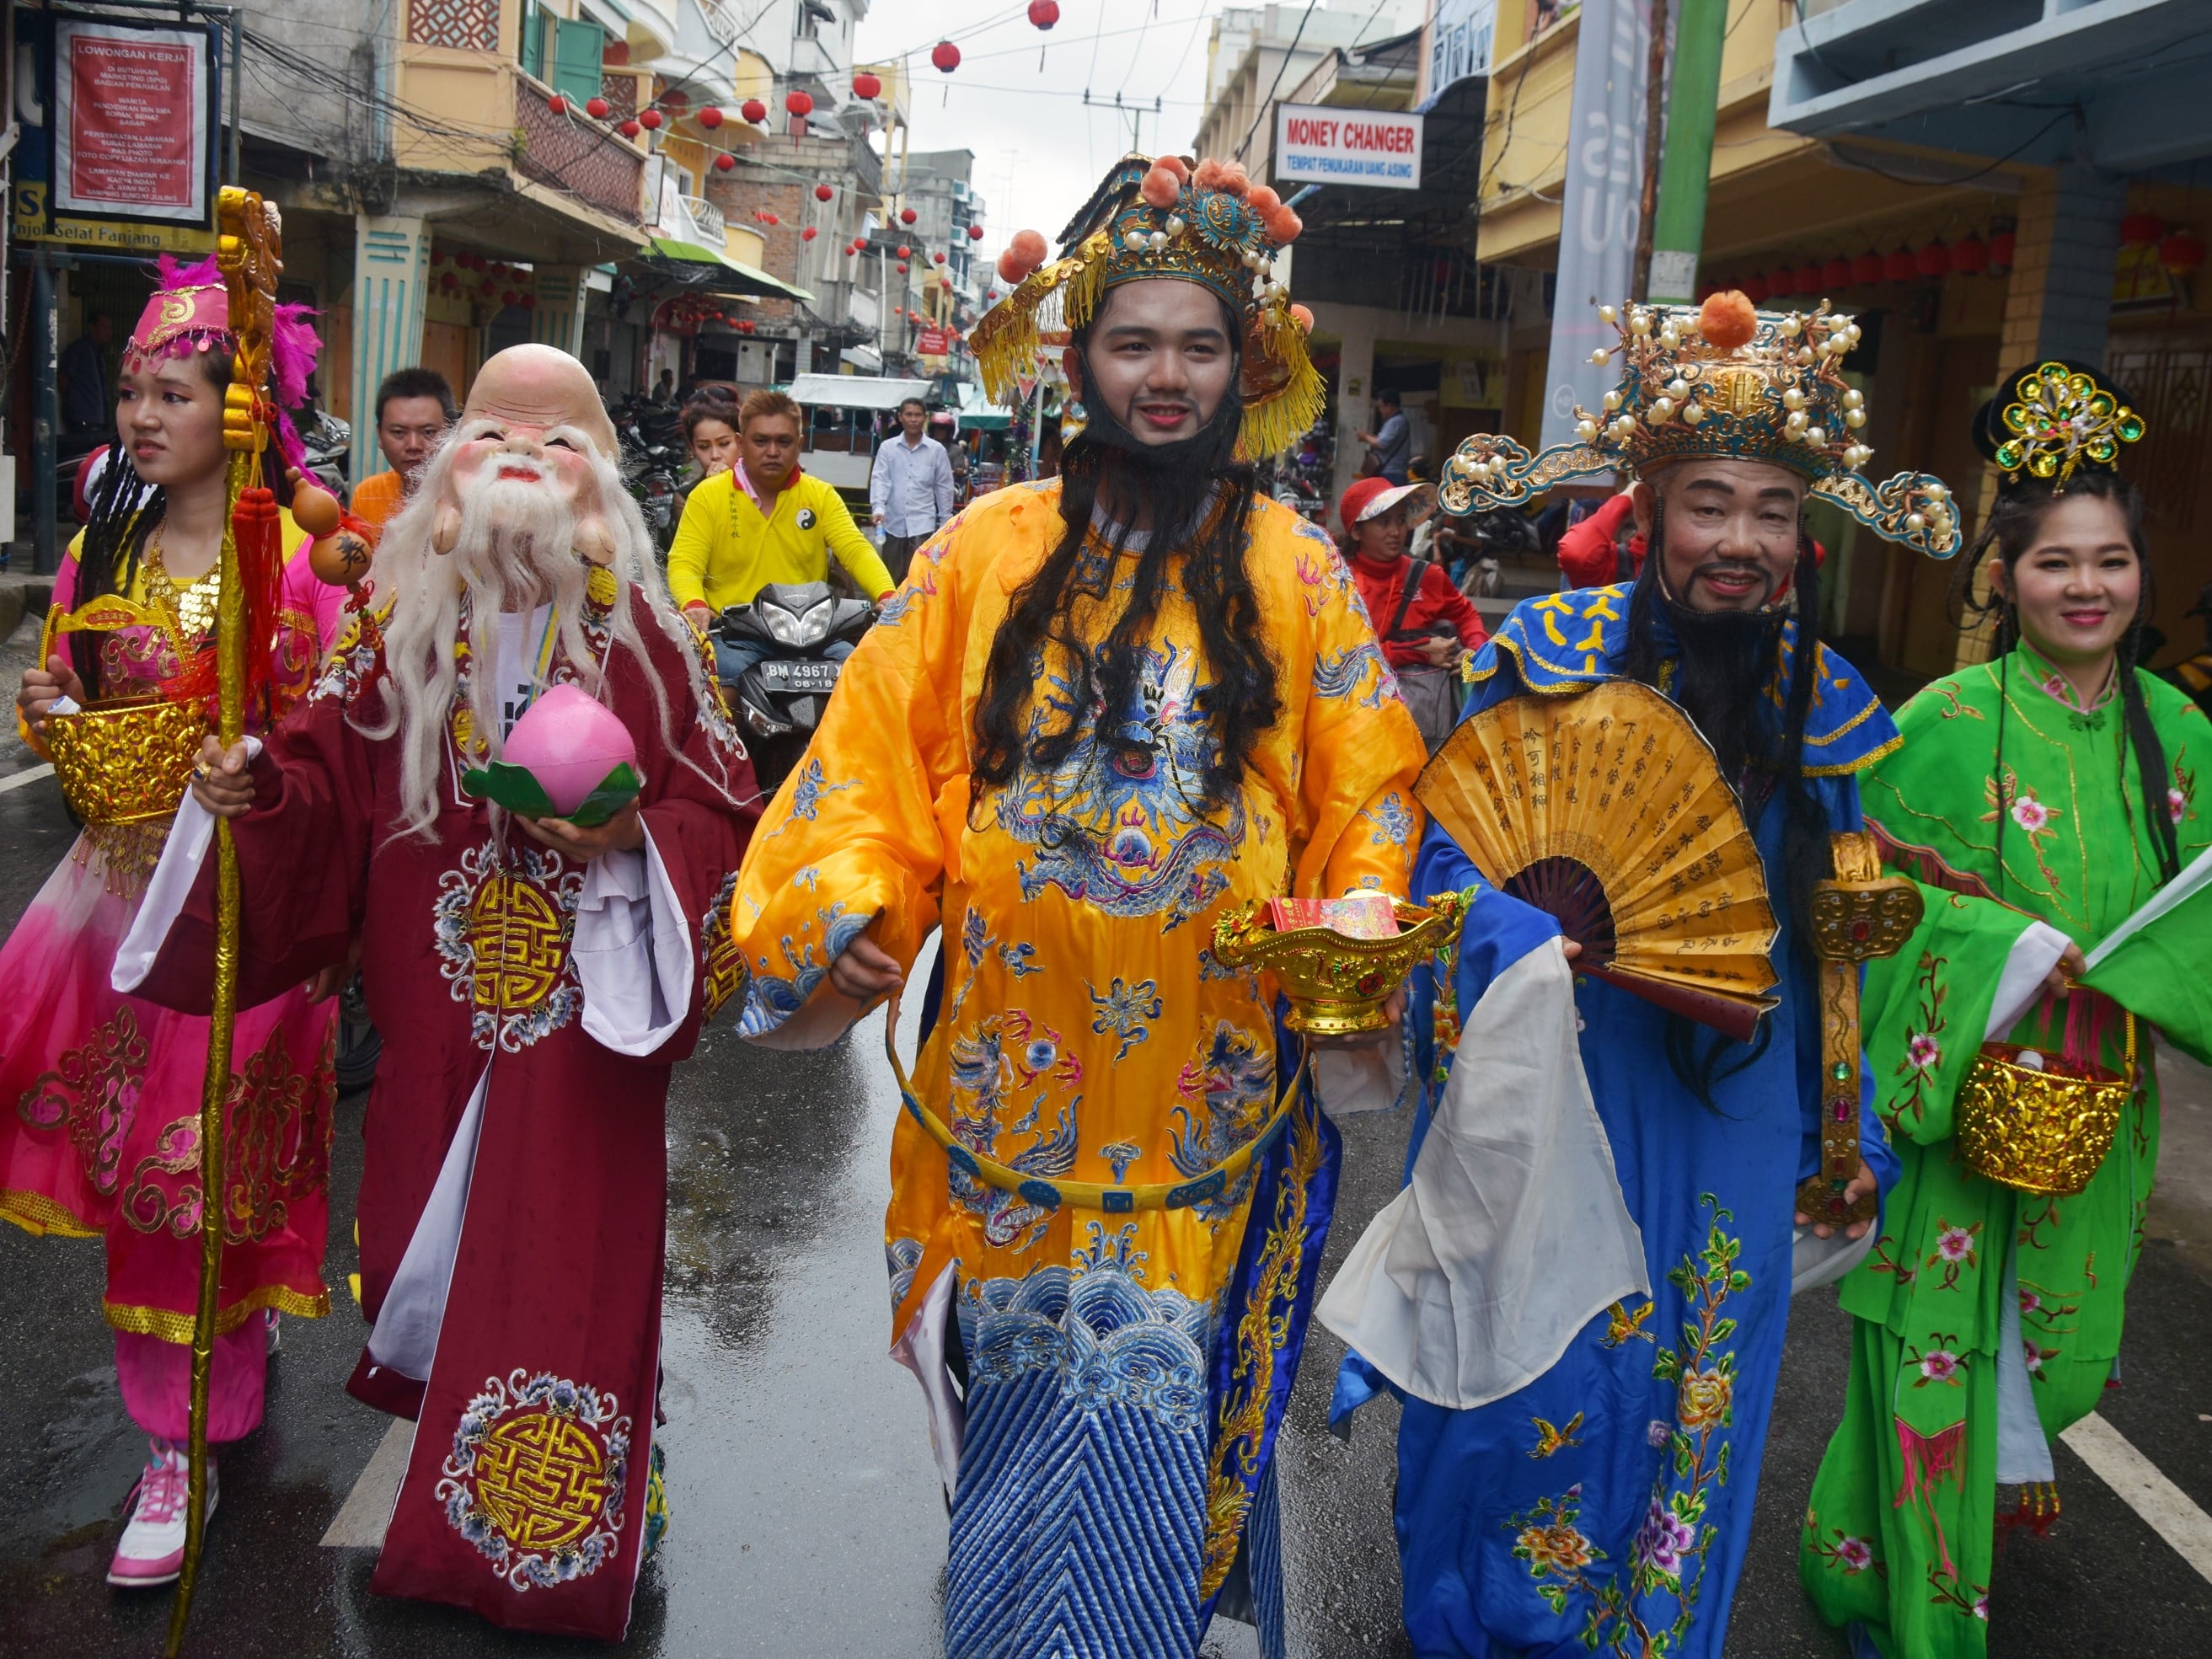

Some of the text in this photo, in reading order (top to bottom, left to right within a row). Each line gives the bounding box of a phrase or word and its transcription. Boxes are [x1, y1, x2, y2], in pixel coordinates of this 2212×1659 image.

[78, 45, 185, 62] LOWONGAN KERJA
[116, 67, 158, 76] BUTUHKAN
[100, 72, 145, 83] MARKETING
[94, 79, 170, 91] BAGIAN PENJUALAN
[94, 102, 138, 112] PENDIDIKAN
[83, 131, 137, 141] PERSYARATAN
[1287, 118, 1414, 153] MONEY CHANGER
[101, 140, 126, 148] SURAT
[78, 151, 98, 159] FOTO
[149, 157, 186, 166] TERAKHIR
[1288, 155, 1412, 178] TEMPAT PENUKARAN UANG ASING
[88, 168, 126, 177] LAMARAN
[86, 189, 120, 197] SAMPING
[17, 222, 46, 237] njol
[55, 224, 93, 240] Selat
[769, 665, 789, 677] BM
[793, 665, 828, 677] 4967
